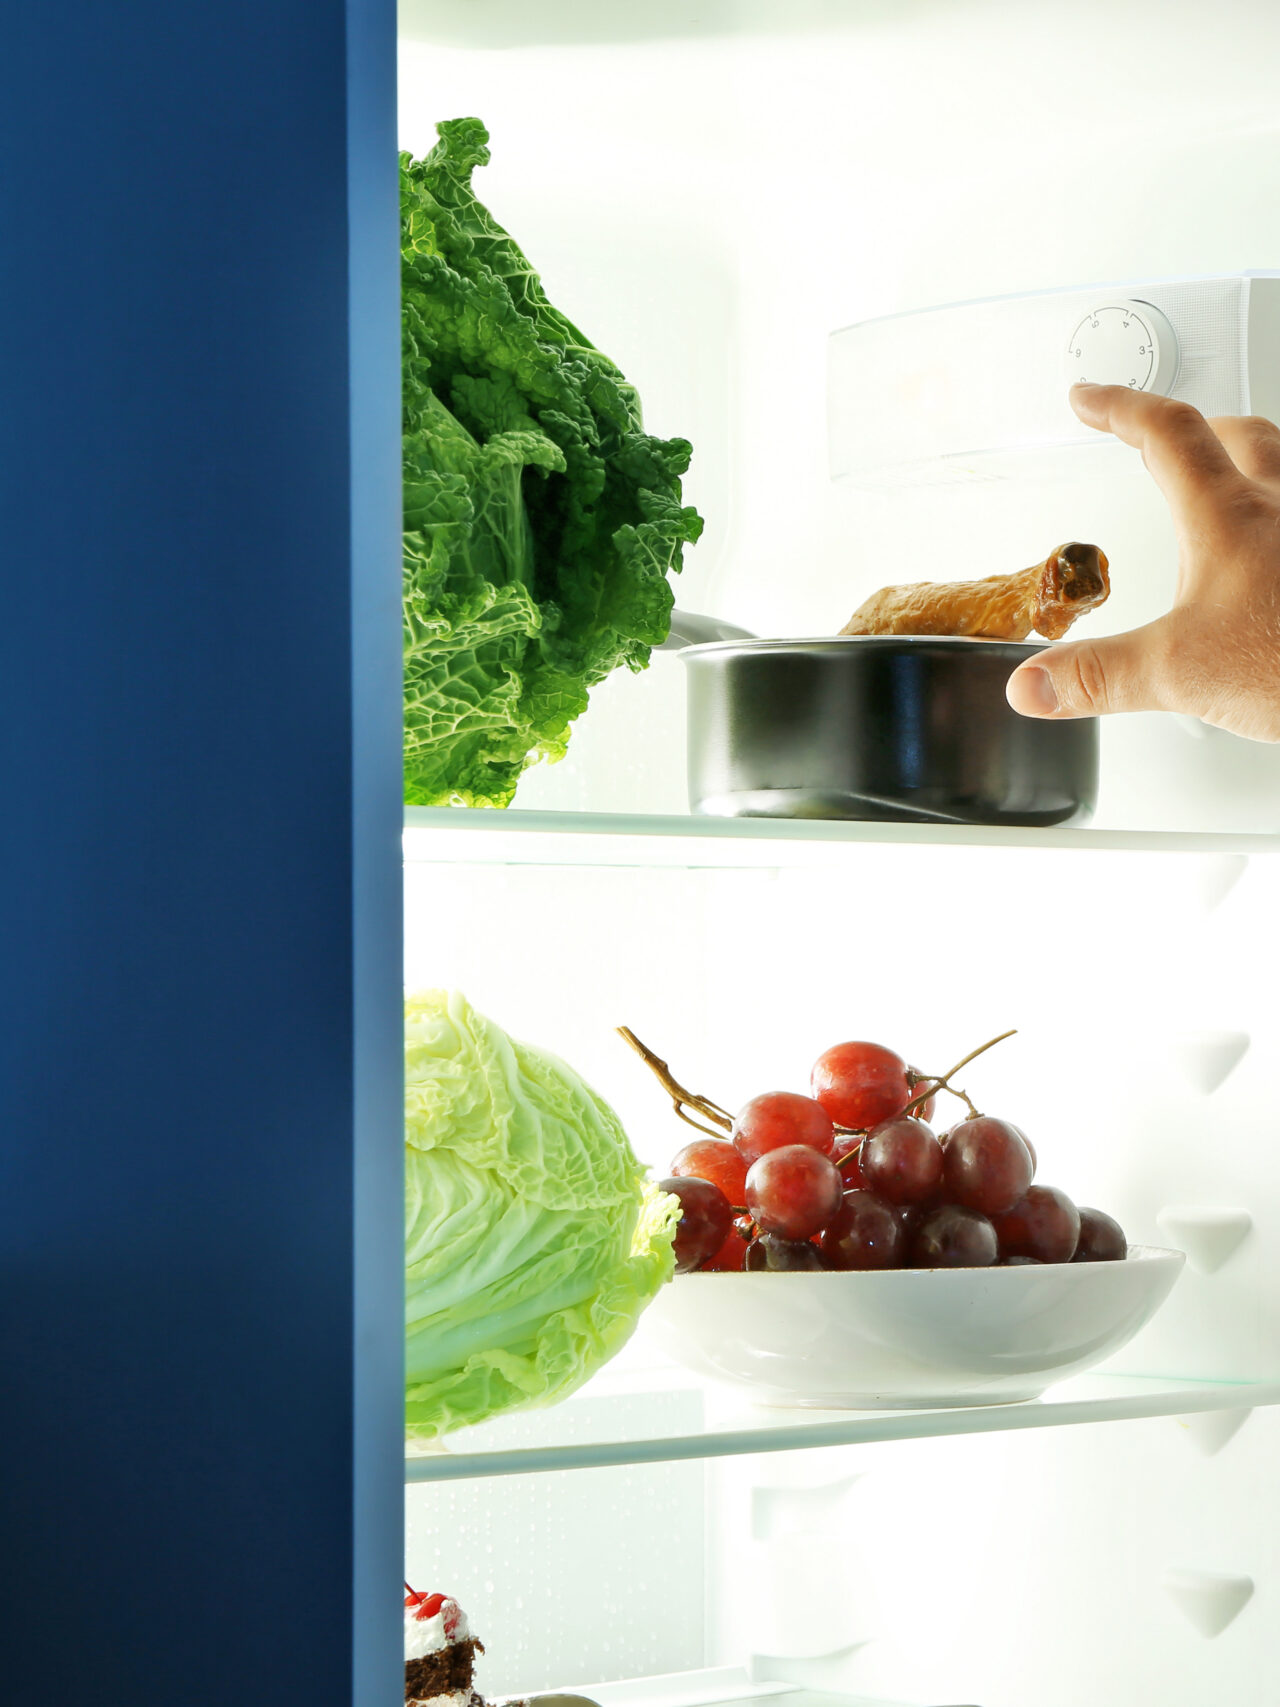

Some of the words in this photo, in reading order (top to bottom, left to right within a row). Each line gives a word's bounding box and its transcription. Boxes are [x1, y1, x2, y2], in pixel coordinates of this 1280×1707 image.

[1091, 320, 1100, 328] 5
[1138, 345, 1146, 355] 3
[1128, 378, 1137, 387] 2
